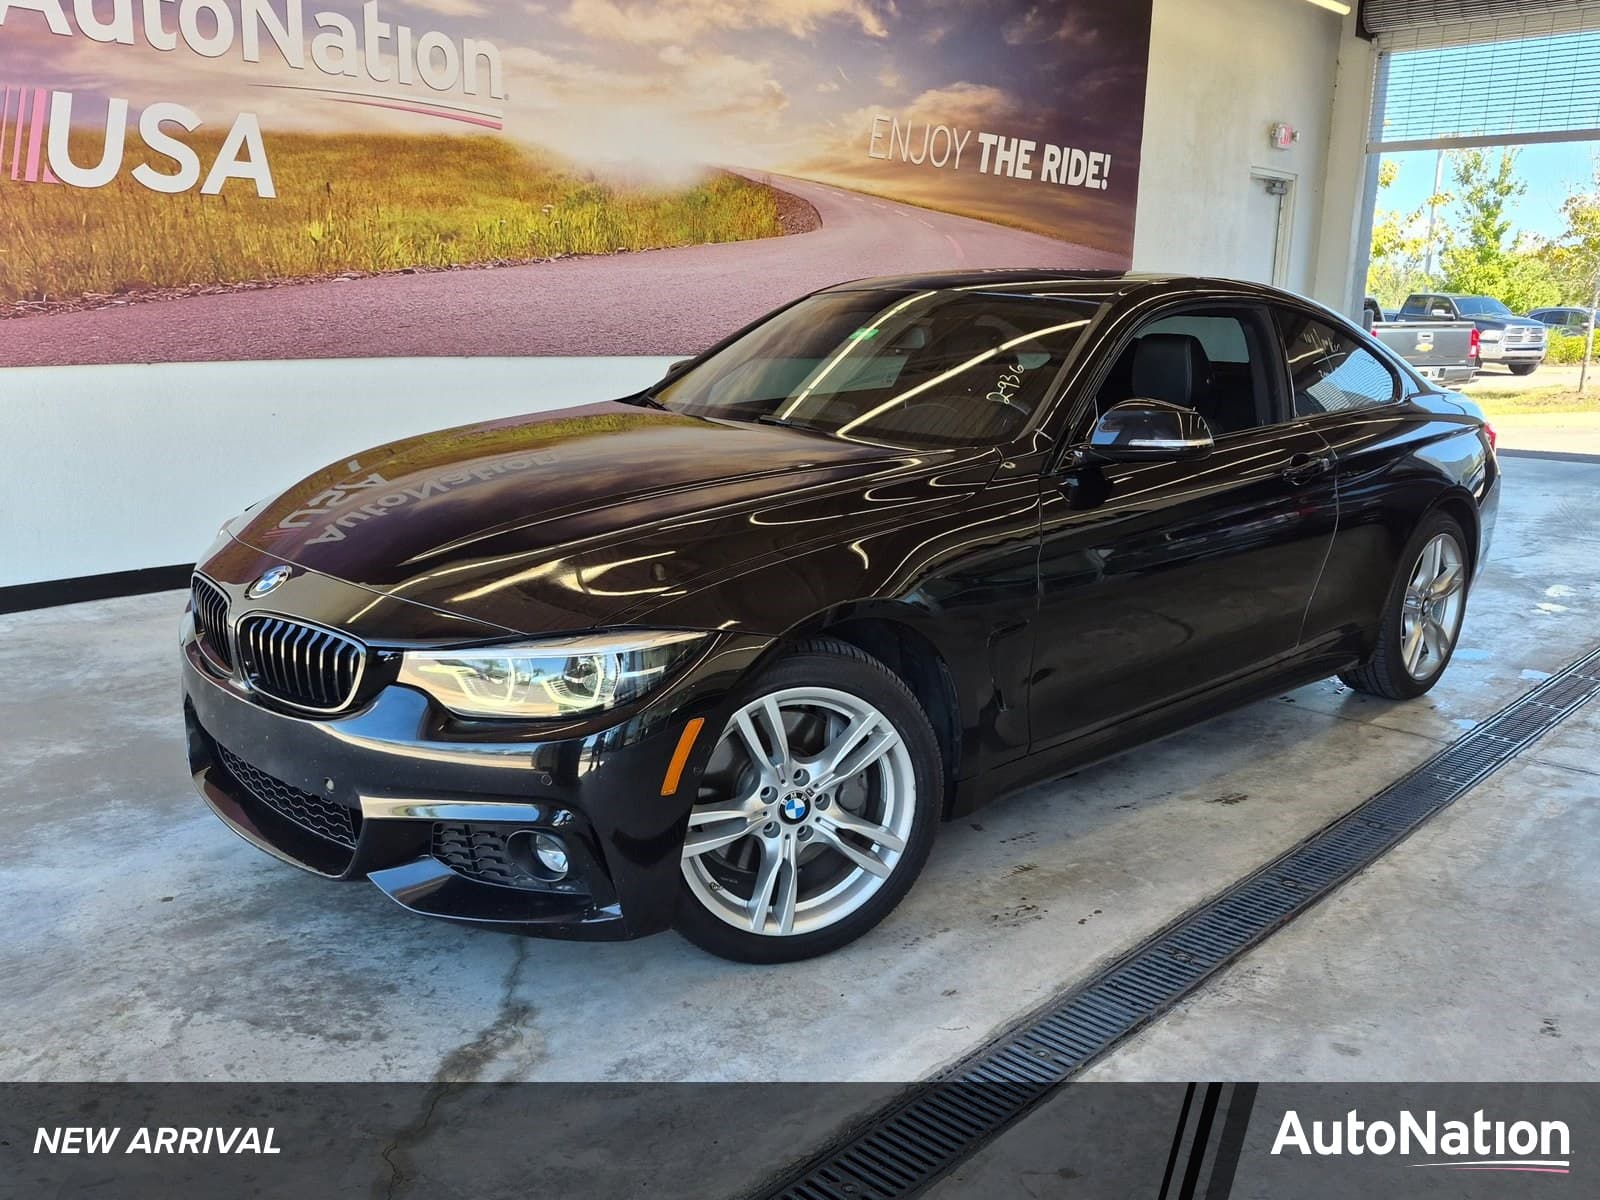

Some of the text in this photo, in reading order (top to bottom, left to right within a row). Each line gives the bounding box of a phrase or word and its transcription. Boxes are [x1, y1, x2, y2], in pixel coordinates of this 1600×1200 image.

[47, 91, 277, 199] USA
[868, 114, 1112, 191] ENJOY THE RIDE!
